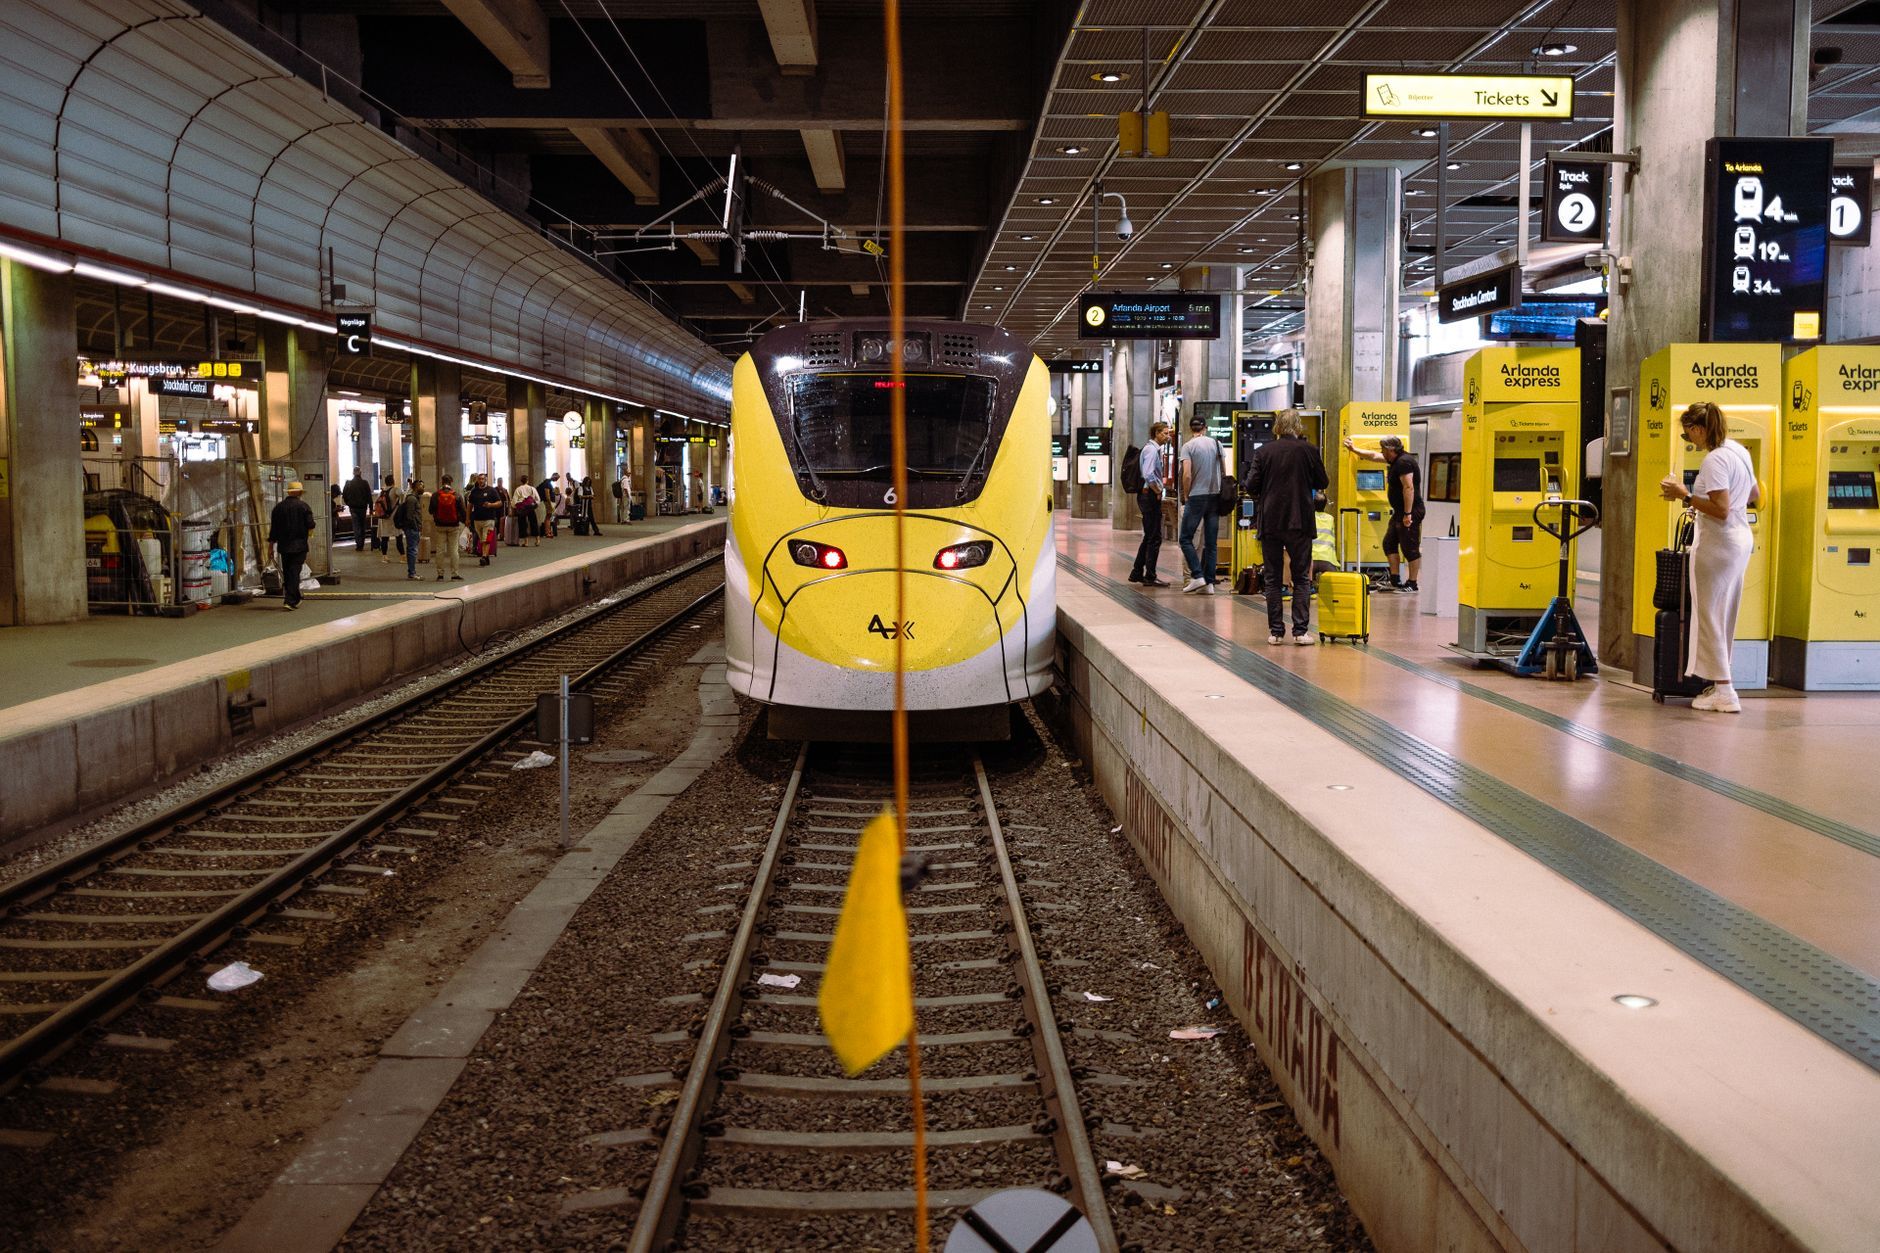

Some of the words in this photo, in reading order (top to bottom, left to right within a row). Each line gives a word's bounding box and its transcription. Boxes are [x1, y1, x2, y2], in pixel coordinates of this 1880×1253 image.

[1474, 91, 1529, 105] Tickets
[1725, 163, 1734, 171] To
[1735, 163, 1762, 171] Arlanda
[1558, 170, 1589, 183] Track
[1569, 201, 1583, 224] 2
[1763, 195, 1784, 222] 4
[1783, 211, 1798, 221] min
[1836, 205, 1844, 227] 1
[1758, 241, 1780, 261] 19
[1752, 279, 1772, 294] 34
[1452, 293, 1477, 311] Stockholm
[1477, 287, 1497, 305] Central
[1111, 303, 1143, 312] Arlanda
[1144, 303, 1170, 313] Airport
[1091, 309, 1099, 322] 2
[347, 335, 360, 352] C
[129, 363, 183, 376] Kungsbron
[1501, 363, 1559, 376] Arlanda
[1692, 362, 1757, 376] Arlanda
[163, 379, 190, 392] Stockholm
[189, 381, 207, 393] Central
[1504, 377, 1560, 388] express
[1696, 377, 1759, 390] express
[1361, 411, 1397, 420] Arlanda
[1646, 419, 1663, 430] Tickets
[1788, 421, 1808, 431] Tickets
[883, 487, 898, 504] 6
[1125, 757, 1174, 883] FÖRBJUDET
[1243, 920, 1340, 1150] BETRÄDA
